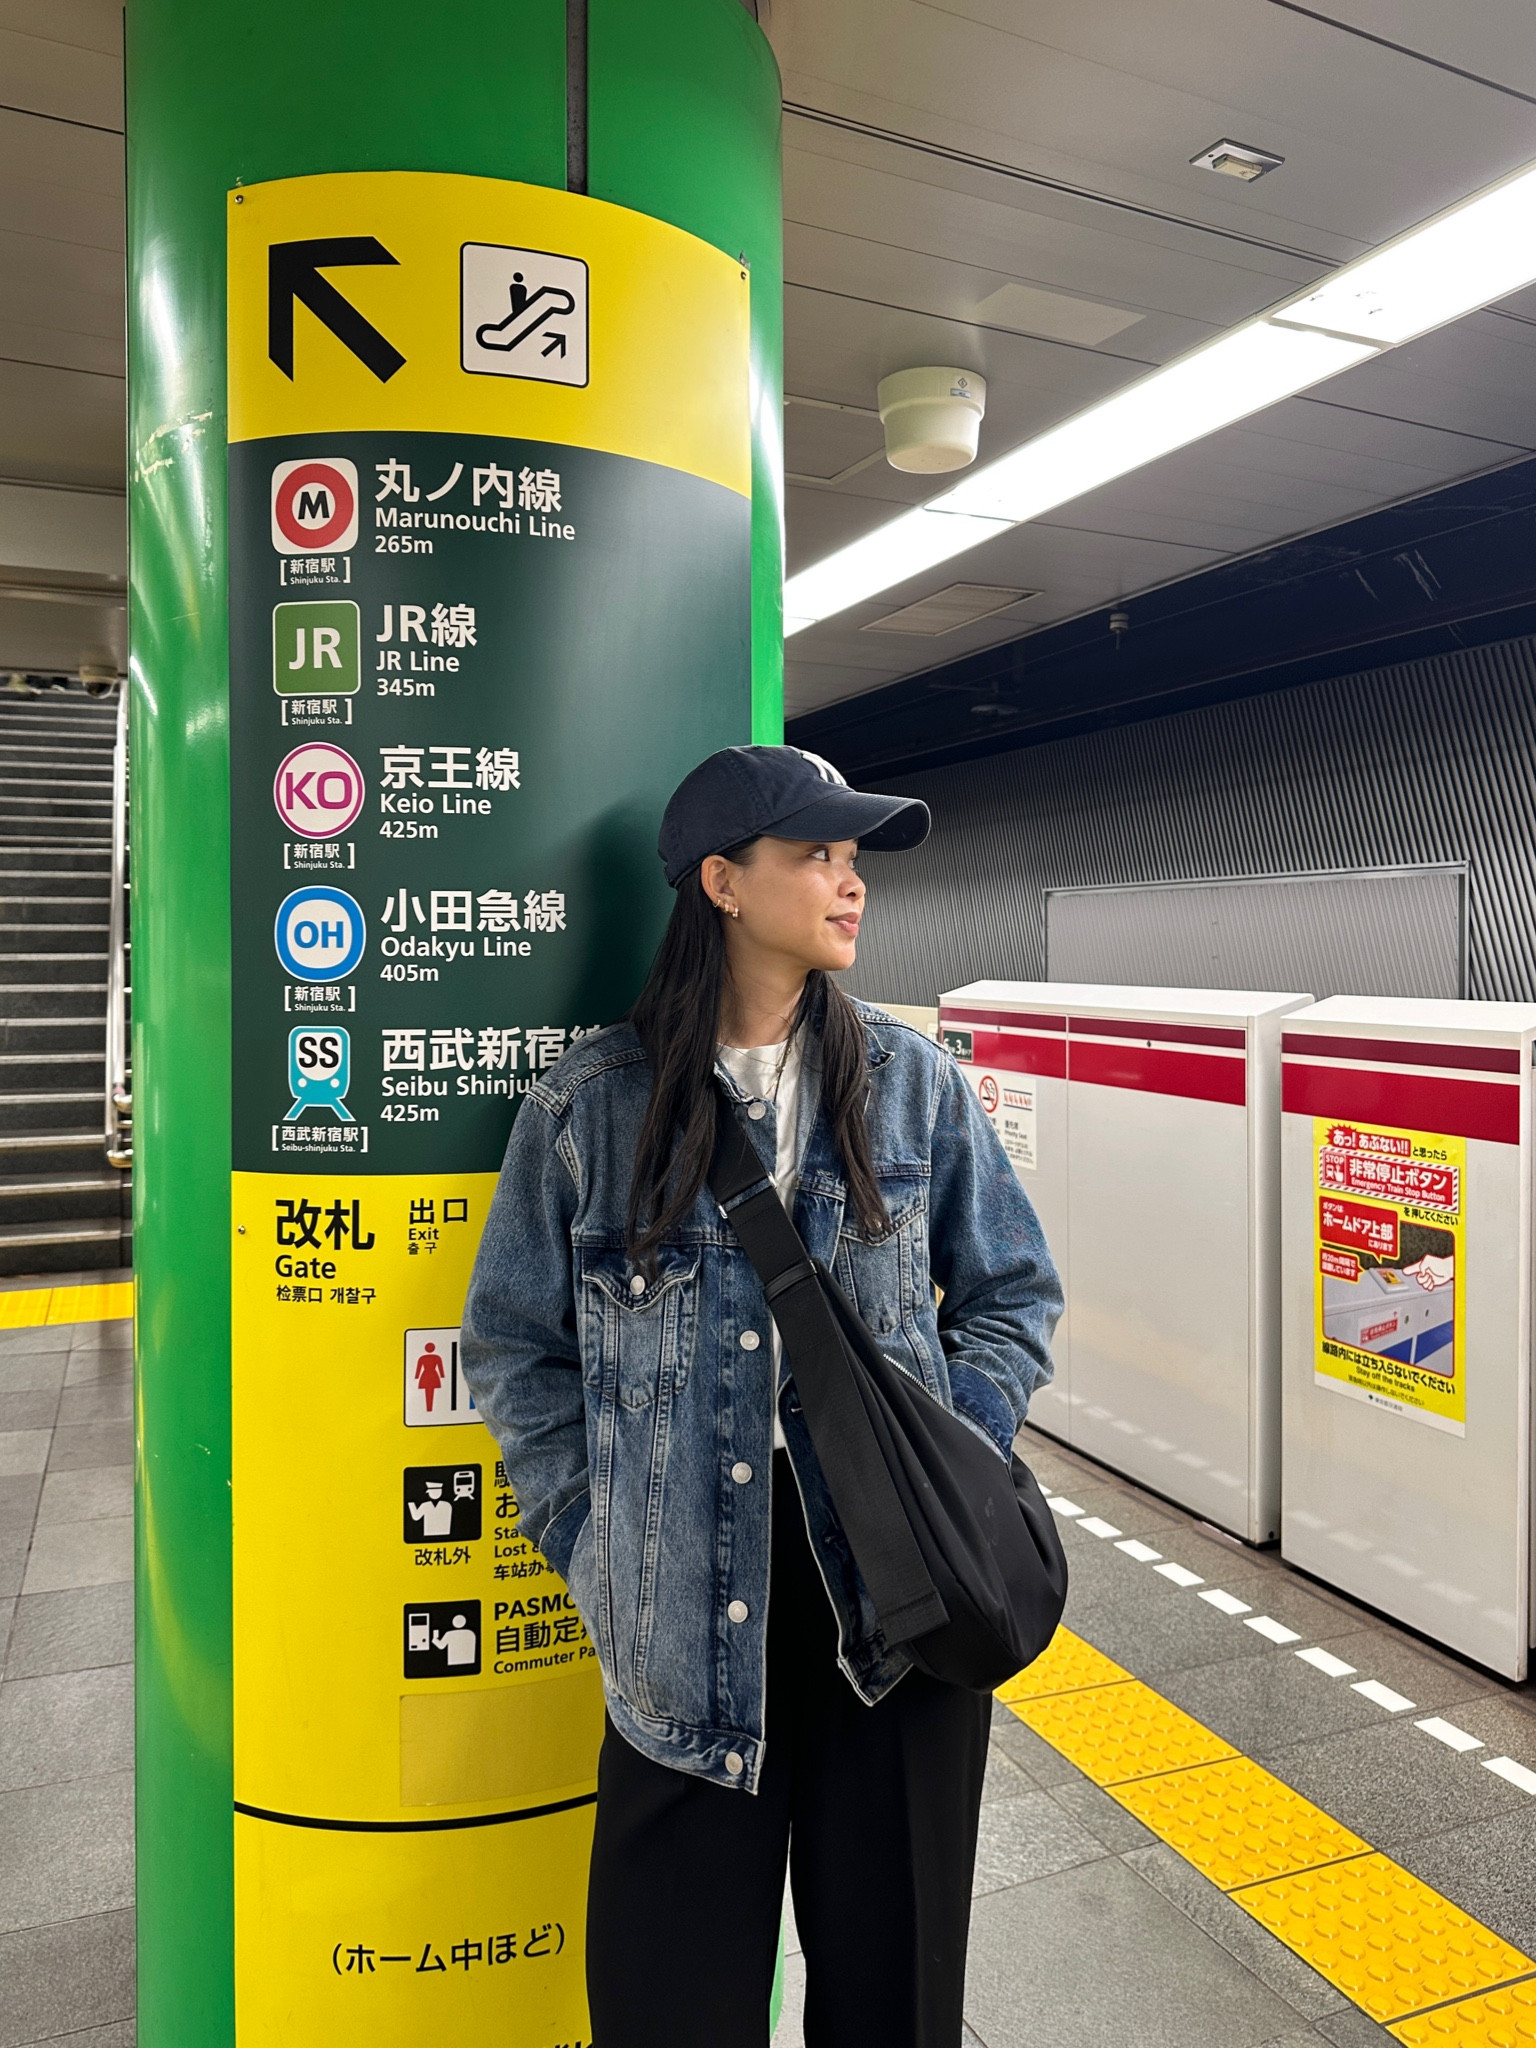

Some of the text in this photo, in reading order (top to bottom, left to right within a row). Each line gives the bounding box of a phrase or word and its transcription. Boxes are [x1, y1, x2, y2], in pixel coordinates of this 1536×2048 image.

[375, 458, 562, 513] 丸ノ内線
[298, 491, 330, 520] M
[375, 508, 576, 540] Marunouchi Line
[375, 535, 433, 554] 265m
[290, 558, 336, 574] 新宿駅
[290, 575, 341, 586] Shinjuku Sta.
[376, 603, 477, 648] JR線
[289, 627, 342, 670] JR
[376, 651, 460, 672] JR Line
[376, 678, 435, 697] 345m
[291, 699, 337, 715] 新宿駅
[291, 716, 342, 726] Shinjuku Sta.
[380, 745, 521, 791] 京王線
[285, 771, 353, 810] KO
[380, 794, 492, 815] Keio Line
[380, 821, 438, 839] 425m
[294, 843, 340, 859] 新宿駅
[294, 860, 345, 870] Shinjuku Sta.
[380, 888, 567, 933] 小田急線
[294, 921, 344, 949] OH
[380, 937, 532, 962] Odakyu Line
[380, 964, 439, 982] 405m
[294, 986, 340, 1001] 新宿駅
[294, 1003, 346, 1012] Shinjuku Sta.
[298, 1036, 339, 1069] SS
[381, 1076, 447, 1097] Seibu
[380, 1104, 439, 1122] 425m
[282, 1126, 359, 1142] 西武新宿駅
[282, 1143, 356, 1153] Seibu-shinjuku Sta.
[1326, 1154, 1344, 1165] STOP
[1349, 1157, 1447, 1191] 非常停止ボタン
[1351, 1178, 1445, 1202] Emergency Train Stop Button
[408, 1198, 468, 1225] 出口
[275, 1198, 375, 1250] 改札
[408, 1228, 439, 1241] Exit
[1323, 1212, 1394, 1241] ホームドア上部
[275, 1255, 337, 1279] Gate
[276, 1285, 377, 1305] 检票口 개찰구
[1356, 1366, 1371, 1379] Stay
[1382, 1375, 1393, 1385] the
[1394, 1379, 1415, 1392] tracks
[494, 1527, 523, 1541] Sta
[414, 1547, 471, 1566] 改札外
[494, 1543, 526, 1559] Lost
[496, 1616, 588, 1655] 自動定
[494, 1651, 575, 1674] Commuter
